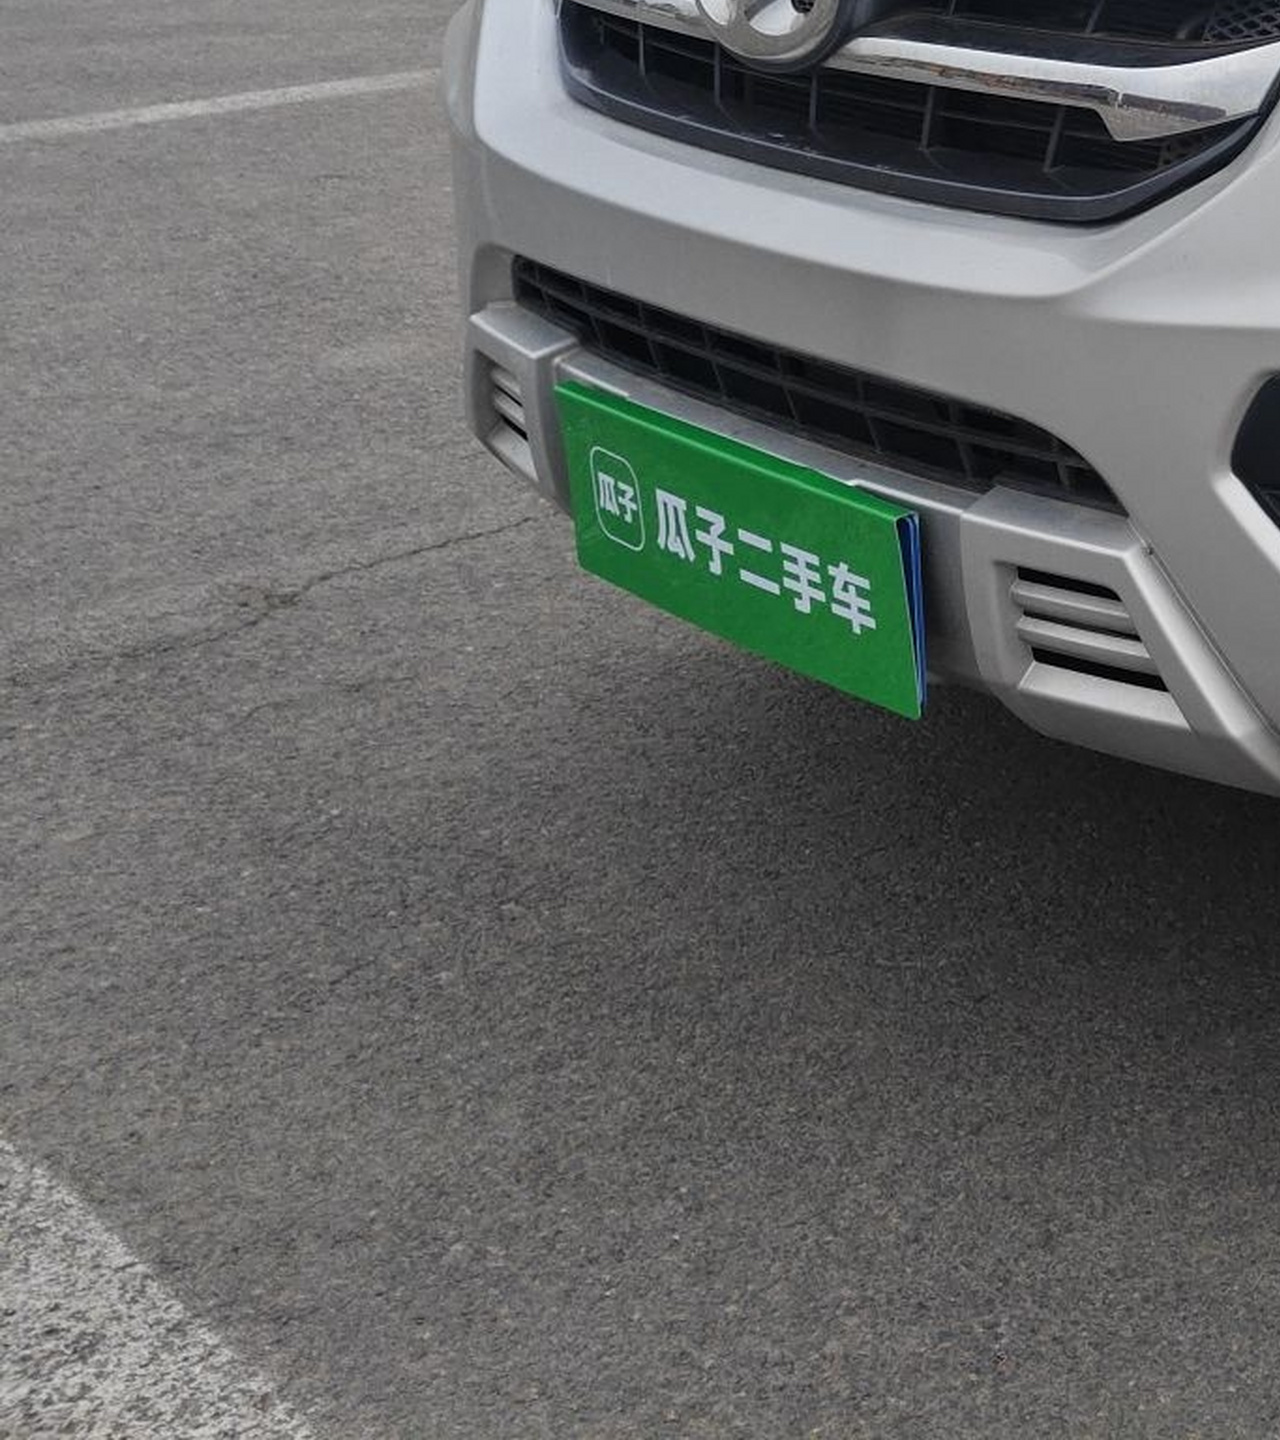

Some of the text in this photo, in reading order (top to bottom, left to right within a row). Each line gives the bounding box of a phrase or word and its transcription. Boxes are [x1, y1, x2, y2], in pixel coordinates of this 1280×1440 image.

[598, 471, 877, 635] 瓜子 瓜子二手车
